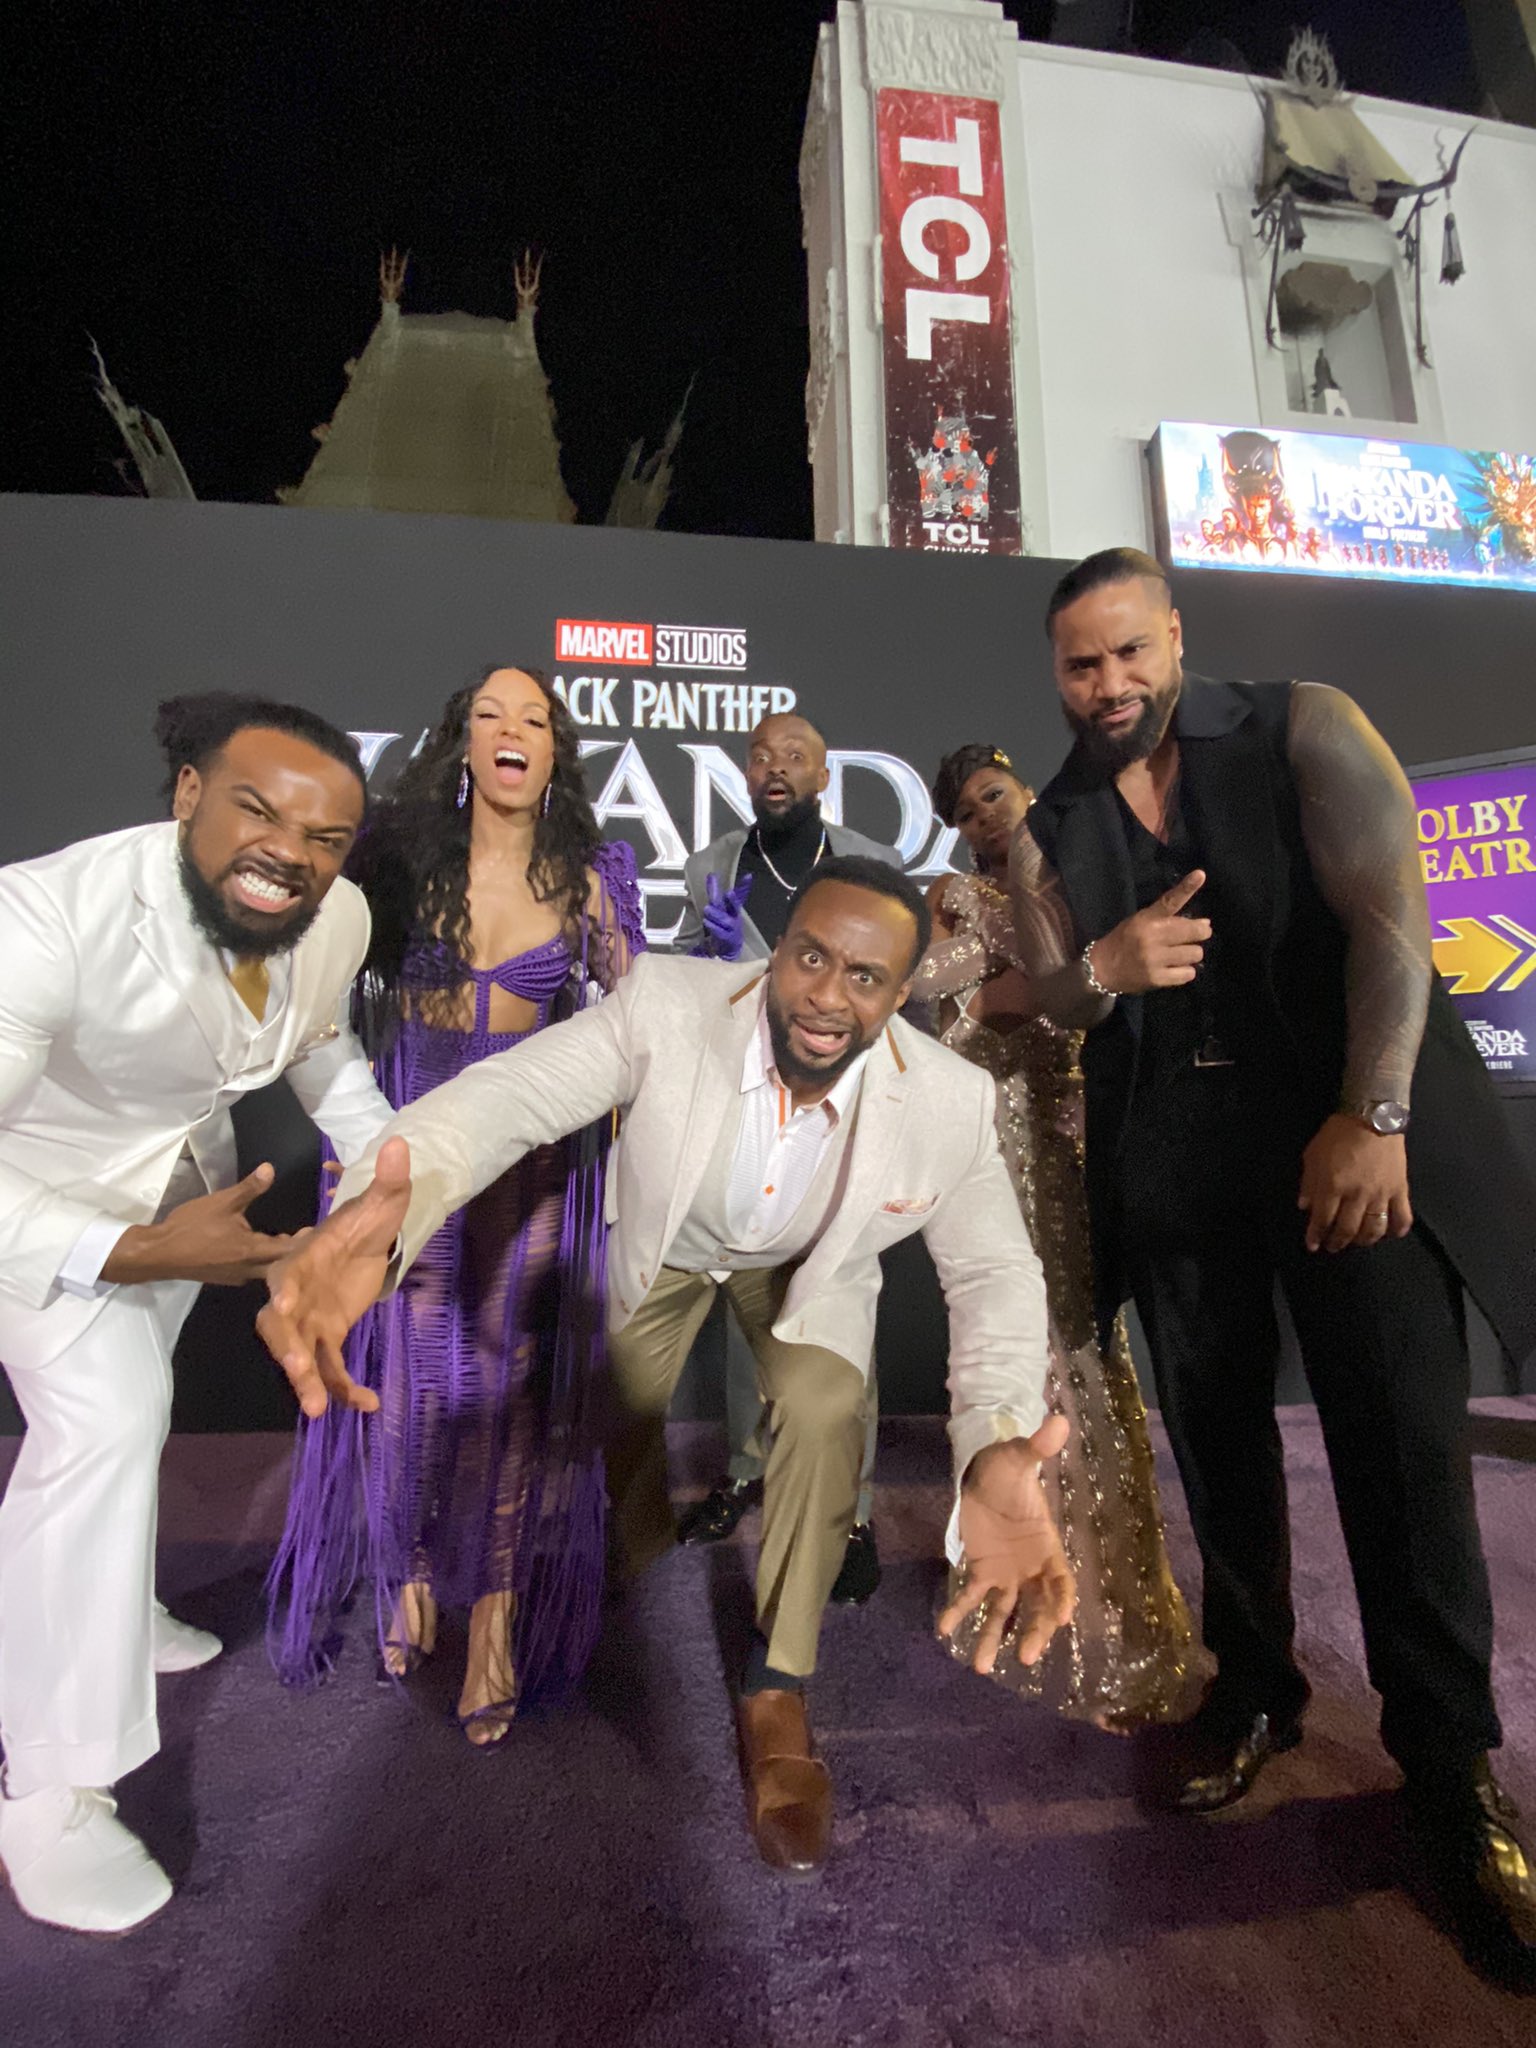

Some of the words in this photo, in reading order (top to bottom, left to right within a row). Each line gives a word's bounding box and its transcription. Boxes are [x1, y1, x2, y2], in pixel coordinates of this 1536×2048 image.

[900, 118, 991, 360] TCL
[1314, 464, 1458, 509] ANDA
[922, 522, 989, 546] TCL
[561, 625, 649, 660] MARVEL
[656, 630, 747, 666] STUDIOS
[553, 675, 620, 726] ACK
[1417, 794, 1527, 843] OLBY
[1419, 838, 1536, 883] EATR
[1470, 1029, 1527, 1043] ANDA
[1476, 1042, 1529, 1057] EVER
